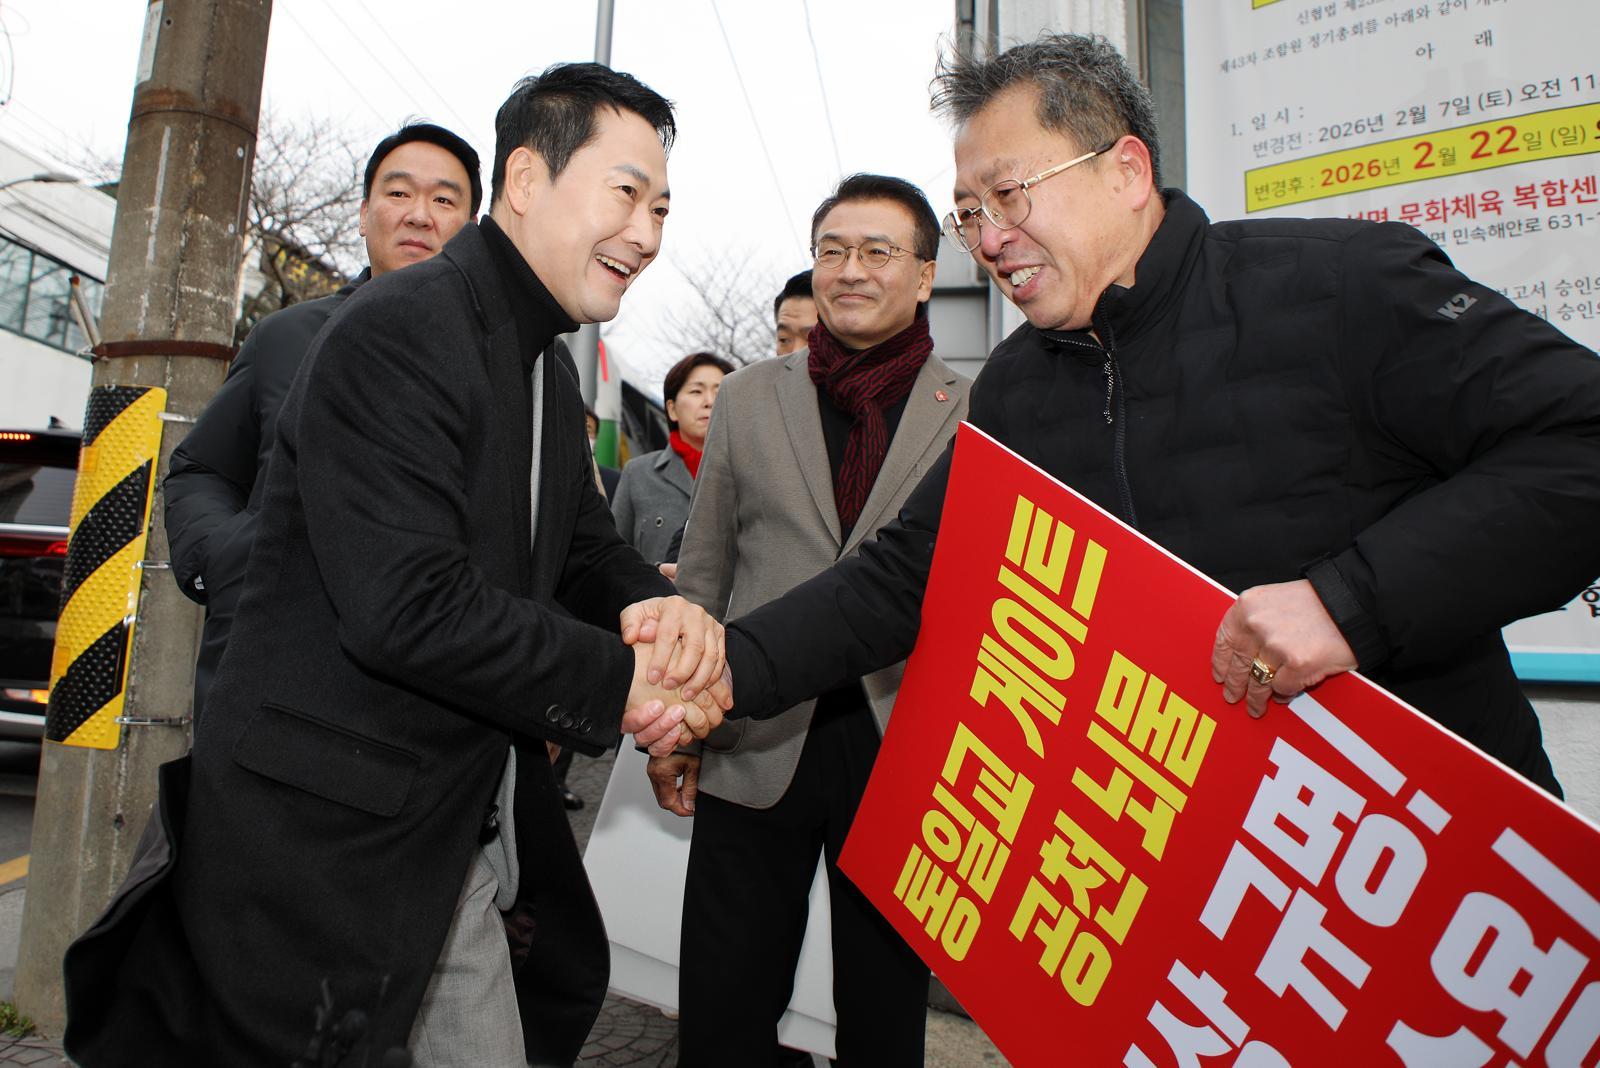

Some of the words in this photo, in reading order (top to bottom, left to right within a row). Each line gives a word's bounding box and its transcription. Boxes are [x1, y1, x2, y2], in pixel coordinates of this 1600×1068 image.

[1385, 5, 1430, 27] 아래와
[1318, 113, 1384, 142] 2026년
[1396, 104, 1426, 126] 2월
[1438, 95, 1471, 118] 7일
[1477, 88, 1513, 112] (토)
[1520, 77, 1562, 101] 오전
[1569, 73, 1600, 92] 11
[1254, 176, 1304, 202] 변경후
[1320, 157, 1401, 188] 2026년
[1413, 141, 1457, 170] 2월
[1470, 125, 1543, 160] 22일
[1550, 124, 1586, 148] (일)
[1399, 191, 1504, 228] 문화체육
[1453, 217, 1543, 246] 민속해안로
[1548, 211, 1600, 231] 631-
[1436, 293, 1478, 320] K2
[892, 720, 1037, 962] 통일교
[968, 493, 1109, 760] 게이트
[1070, 650, 1218, 862] 뇌물
[1198, 690, 1453, 1032] 규명!
[1008, 808, 1150, 1007] 공천
[1122, 957, 1292, 1068] 상
